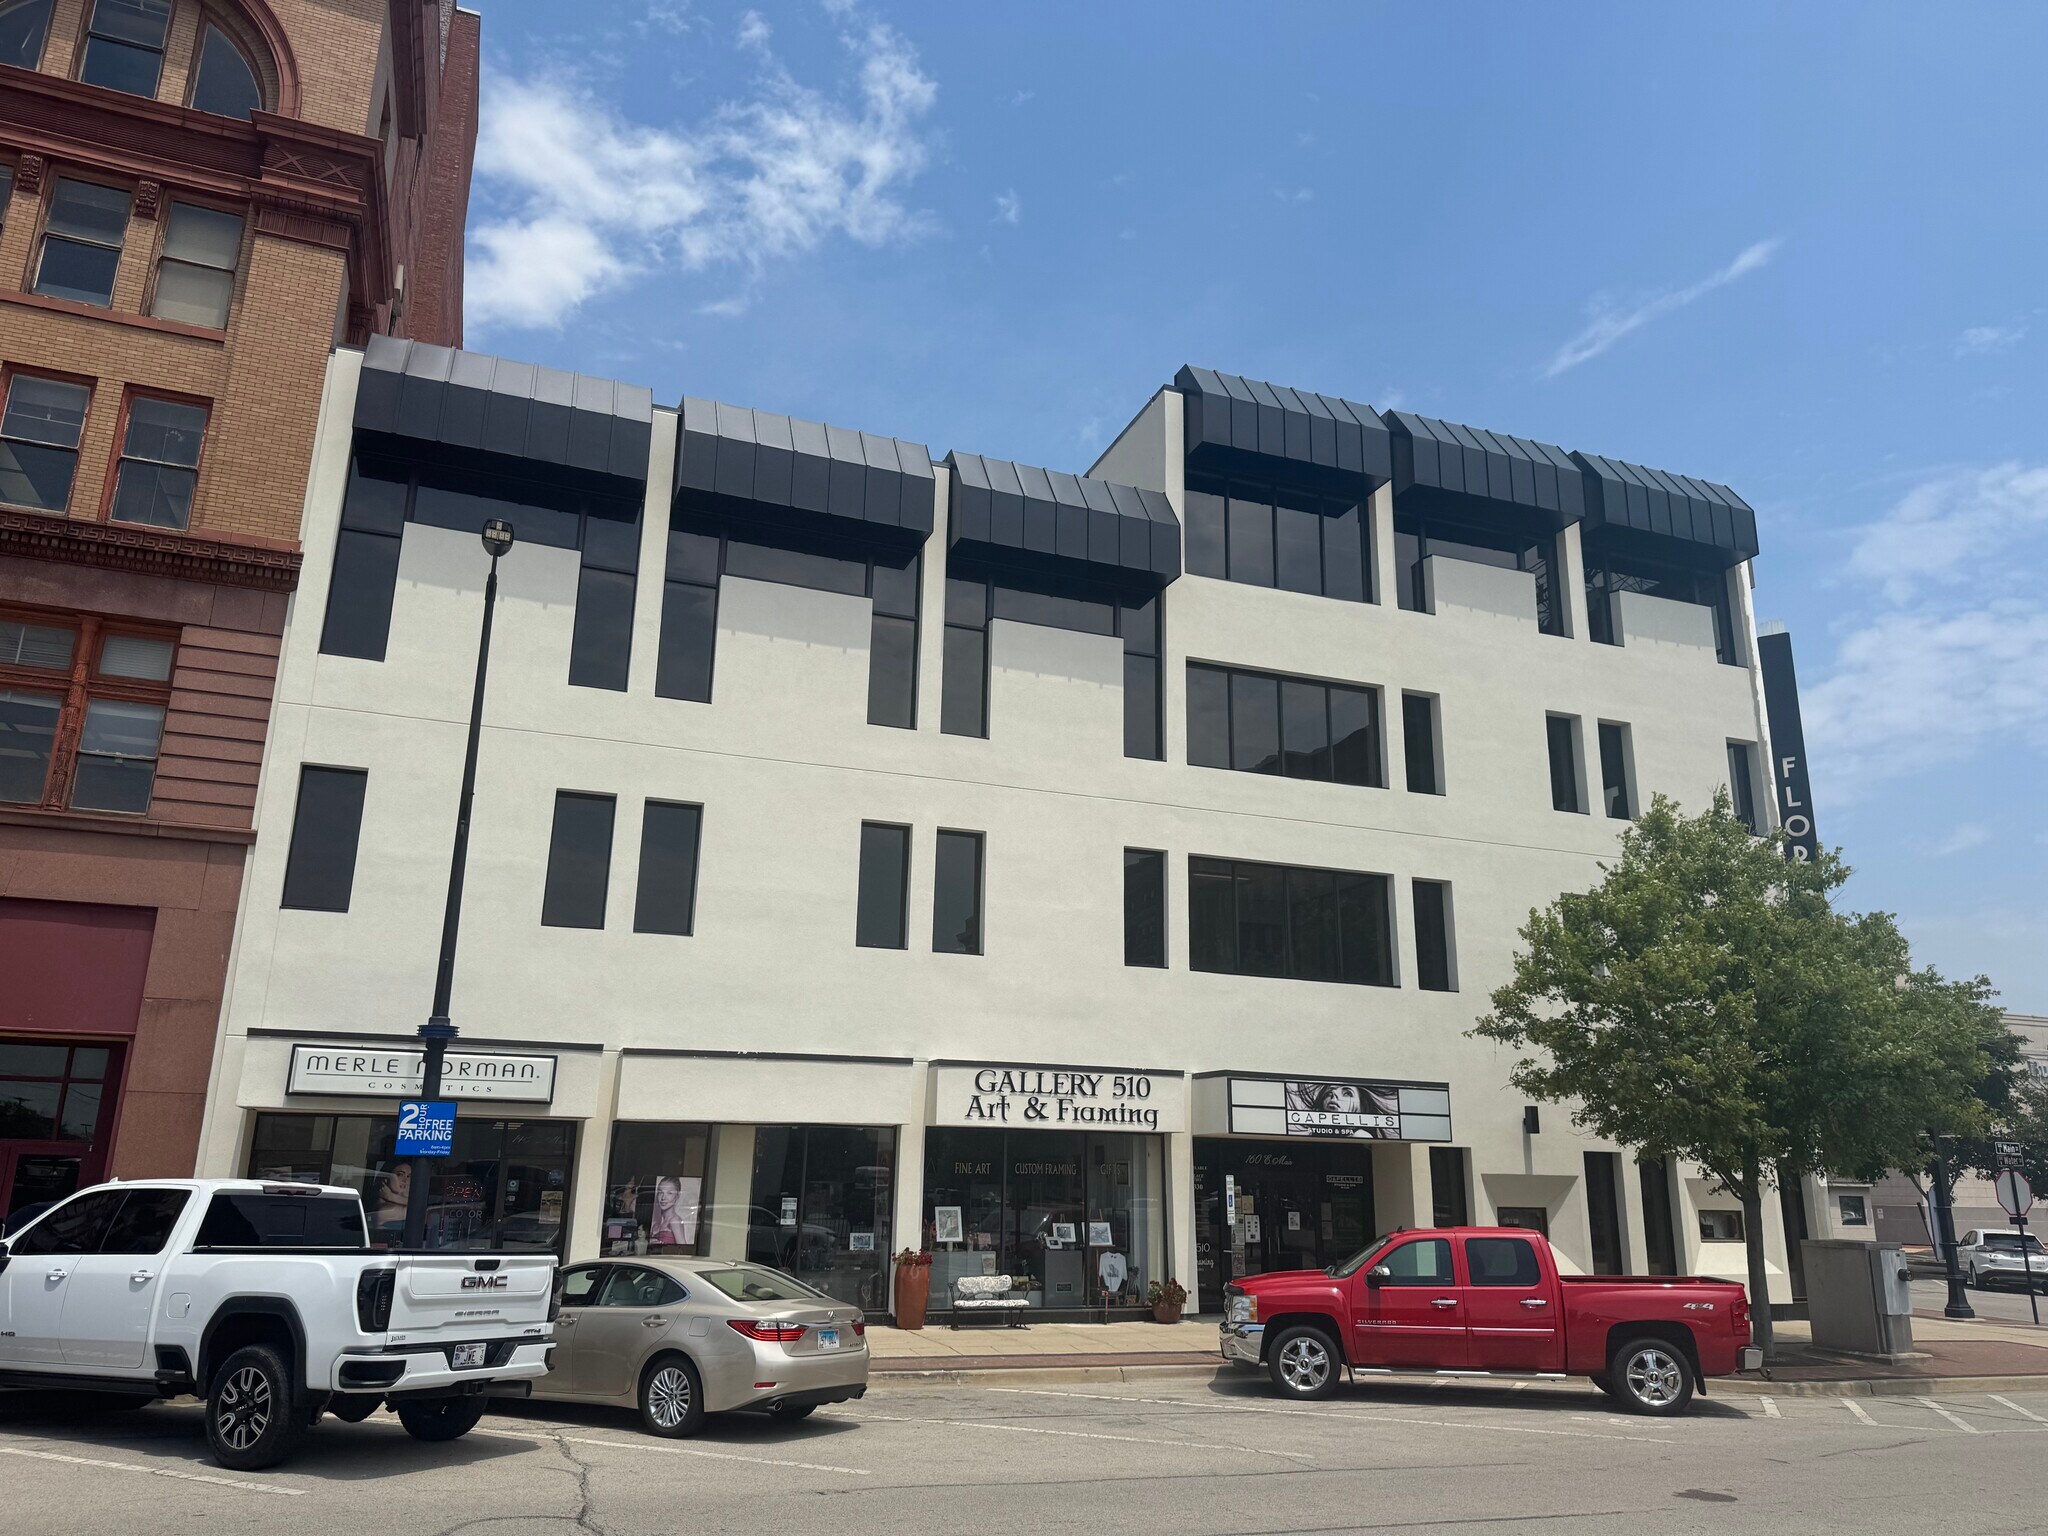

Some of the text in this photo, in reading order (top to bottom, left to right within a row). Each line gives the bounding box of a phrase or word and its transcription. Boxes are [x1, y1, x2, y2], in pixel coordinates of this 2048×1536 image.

[306, 1055, 400, 1074] MERLE
[368, 1082, 492, 1093] COSMTICS
[974, 1069, 1151, 1098] GALLERY 510
[399, 1103, 420, 1130] 2
[417, 1103, 428, 1130] HOUR
[965, 1095, 1159, 1131] Art & Framing
[1291, 1112, 1395, 1127] CAPELLIS
[424, 1119, 454, 1131] FREE
[398, 1129, 452, 1141] PARKING
[954, 1162, 992, 1175] FINE ART
[1014, 1162, 1078, 1176] CUSTOM FRAMING
[449, 1209, 483, 1219] COOR
[461, 1275, 508, 1289] GMC
[454, 1309, 500, 1317] SIERRA
